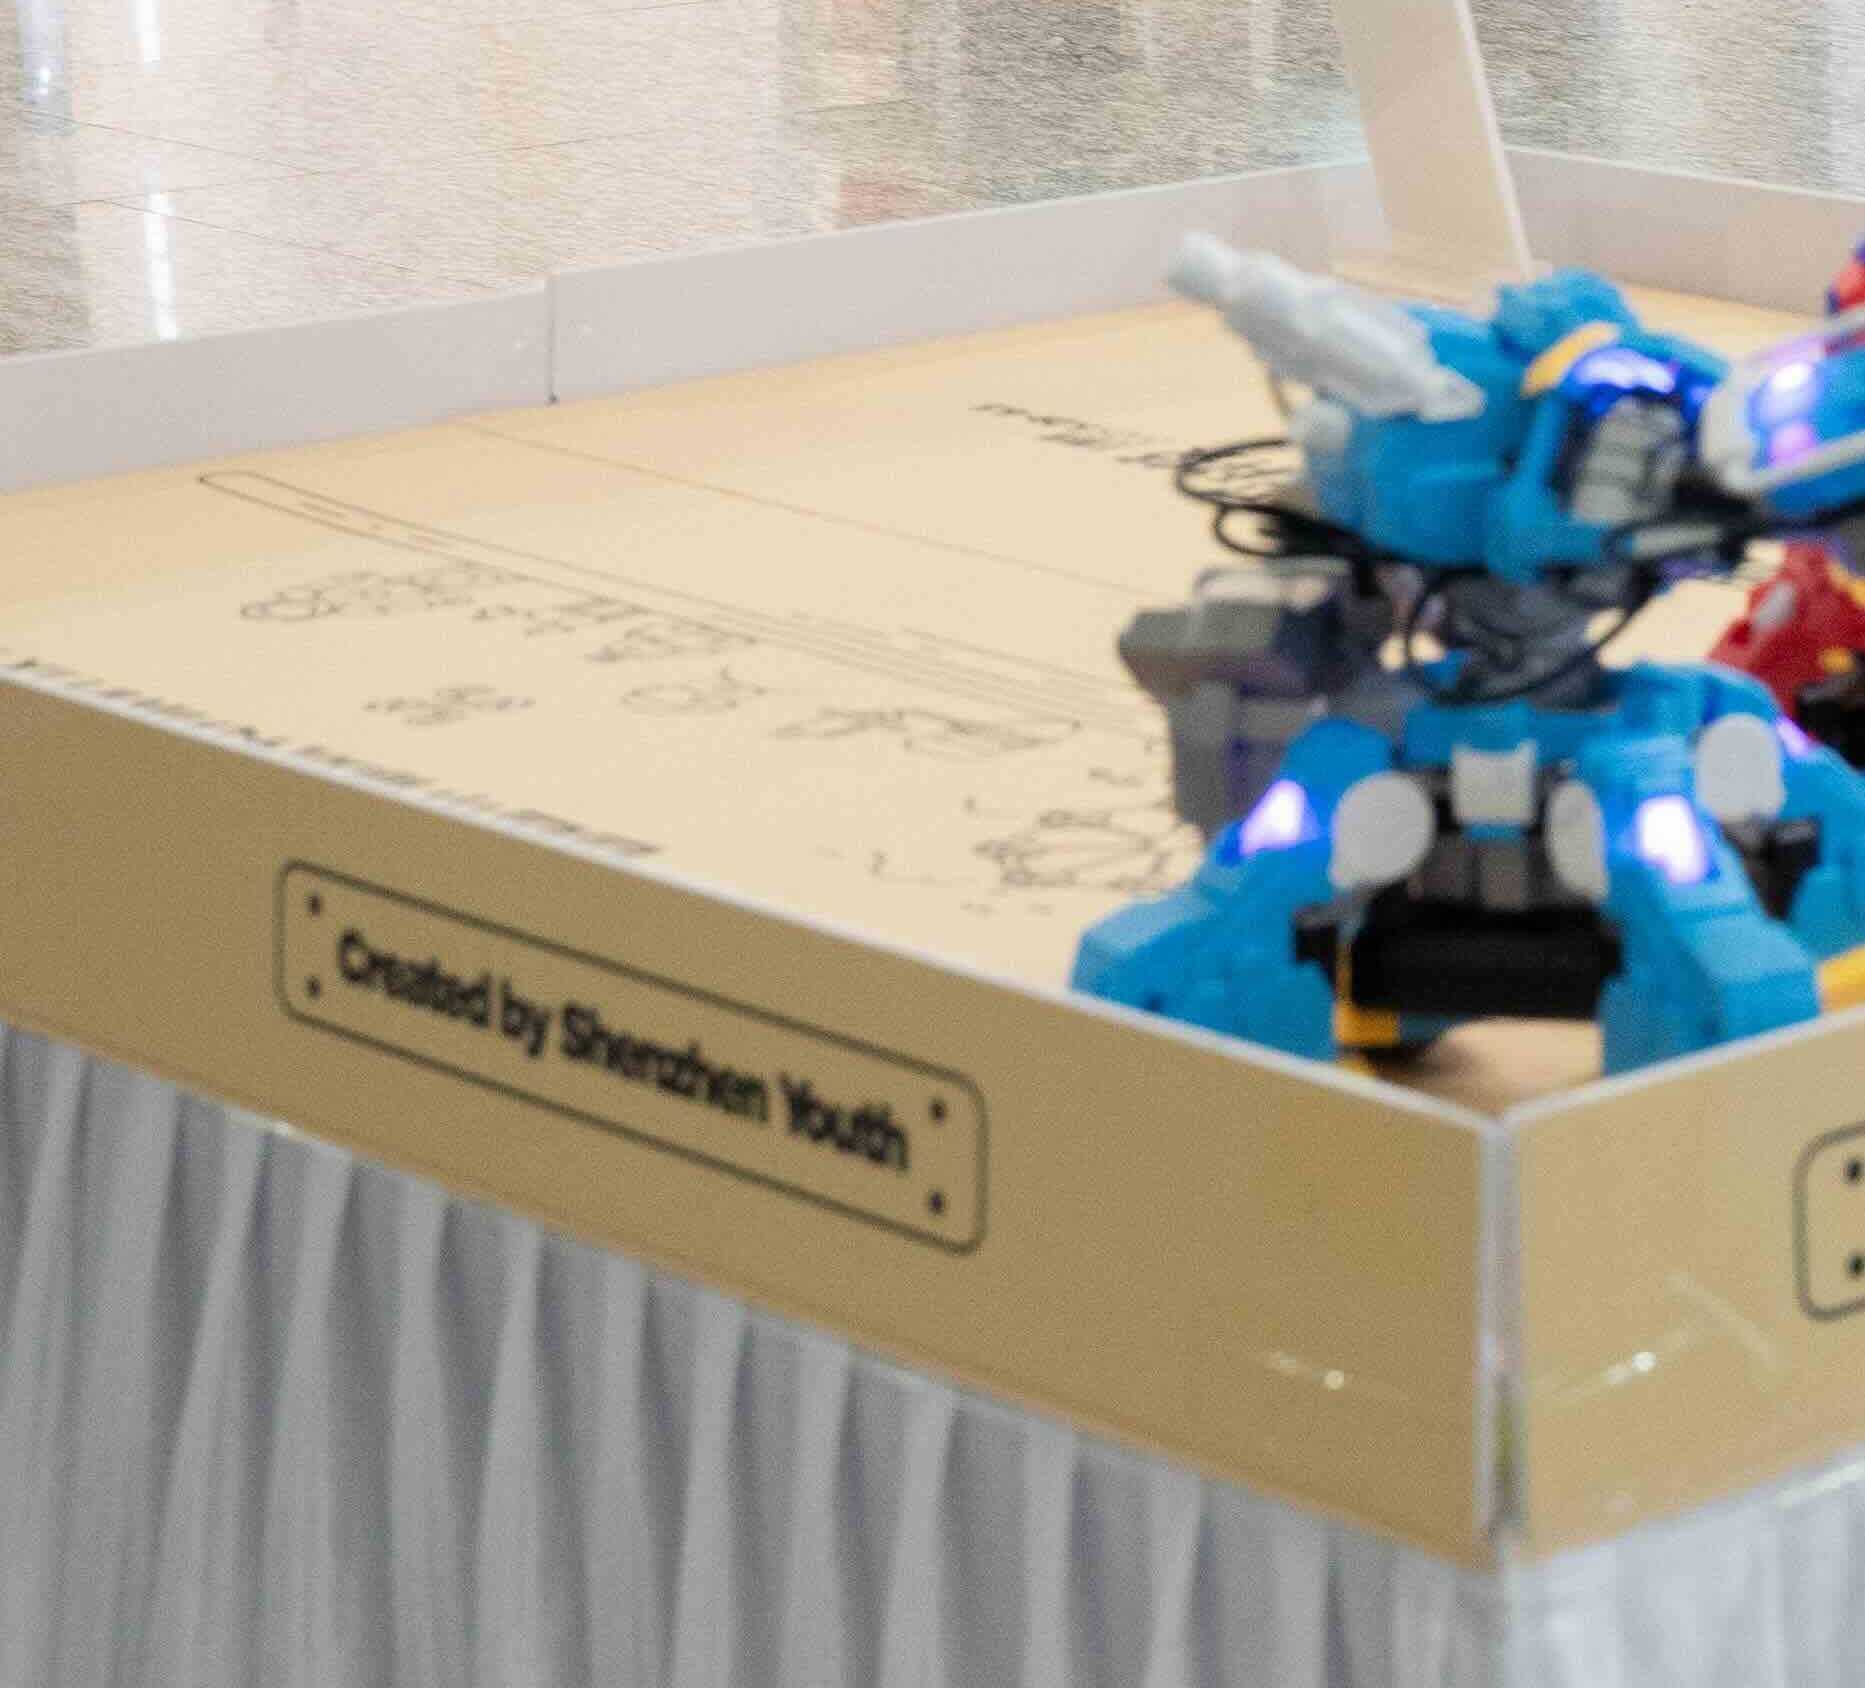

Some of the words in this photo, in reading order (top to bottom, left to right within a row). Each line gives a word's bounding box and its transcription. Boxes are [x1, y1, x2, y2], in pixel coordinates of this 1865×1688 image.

[336, 928, 490, 1028] Created
[500, 977, 554, 1058] by
[561, 1007, 769, 1124] Shenzhen
[776, 1070, 909, 1172] Youth
